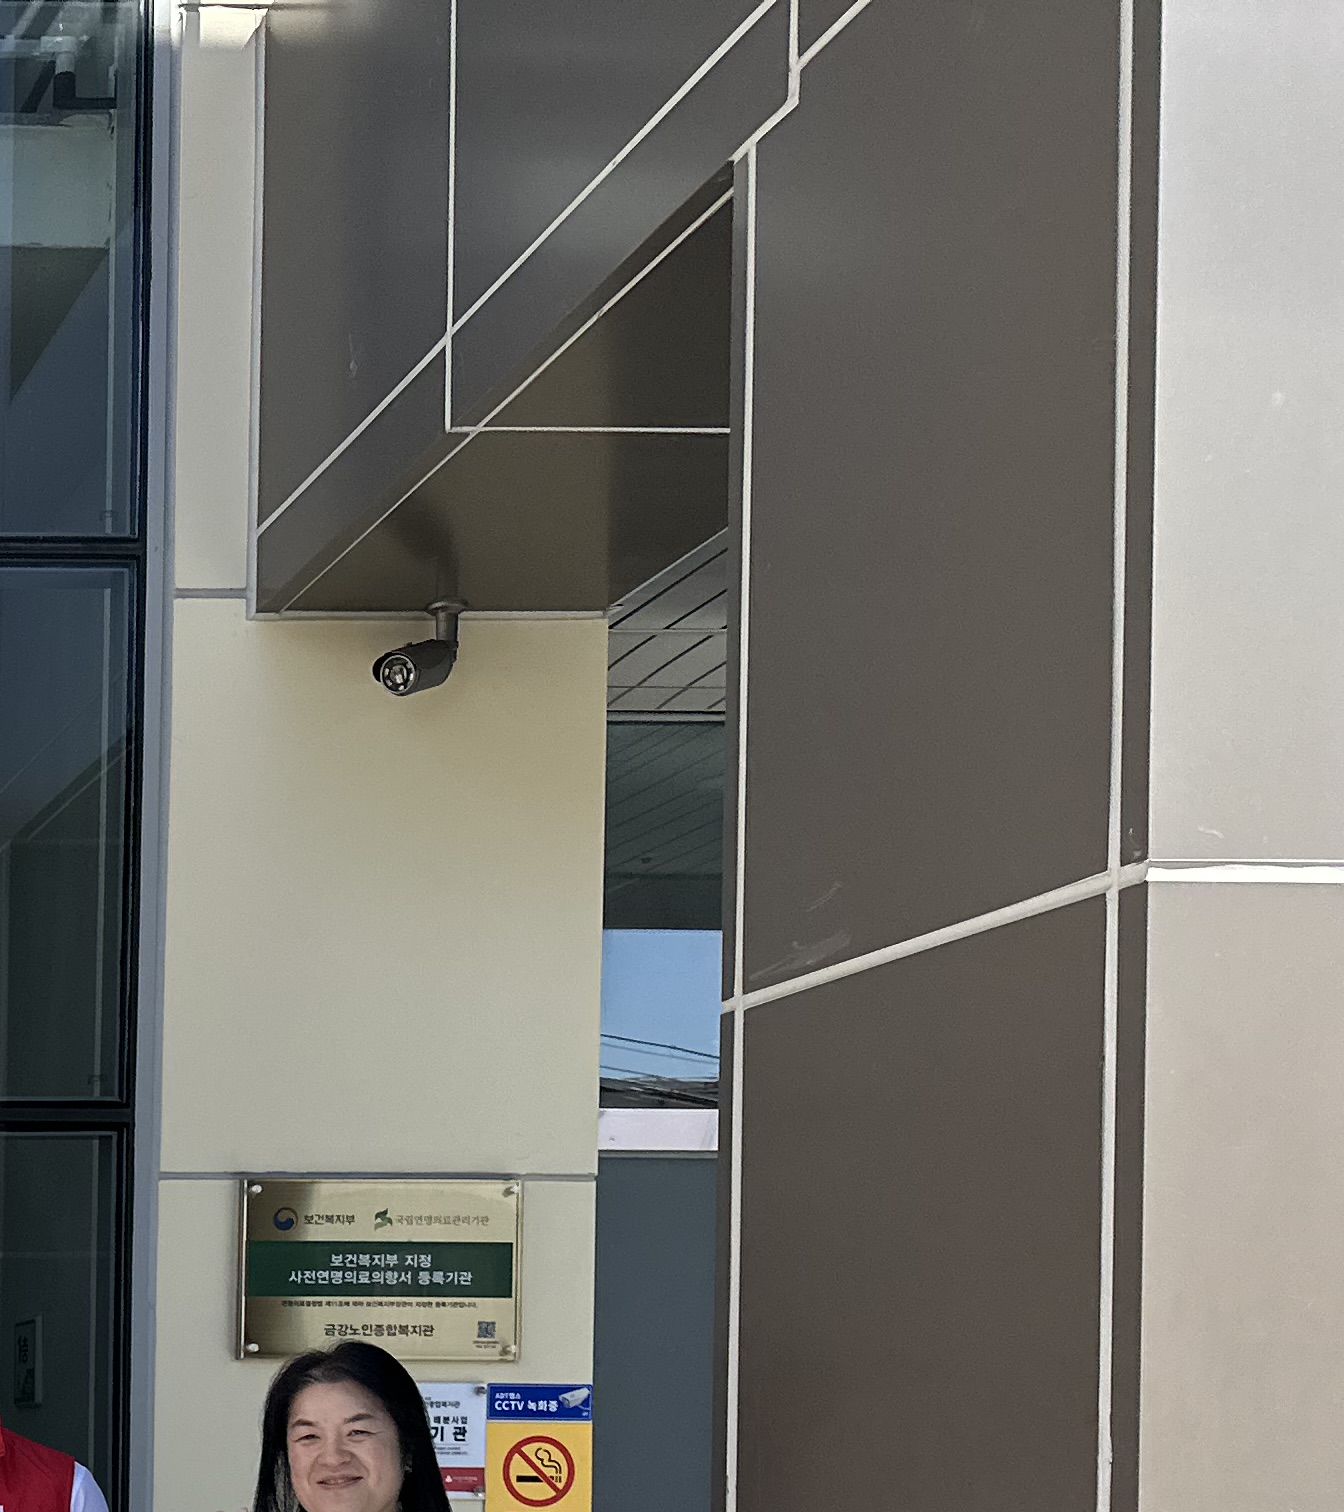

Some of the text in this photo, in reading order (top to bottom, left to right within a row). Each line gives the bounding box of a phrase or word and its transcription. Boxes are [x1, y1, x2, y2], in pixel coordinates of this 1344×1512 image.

[304, 1215, 355, 1225] 보건복지부
[330, 1254, 432, 1268] 보건복지부 지정
[289, 1271, 472, 1285] 사전연명의료의향서 등록기관
[324, 1324, 435, 1337] 금강노인종합복지관
[495, 1400, 558, 1412] CCTV 녹화중
